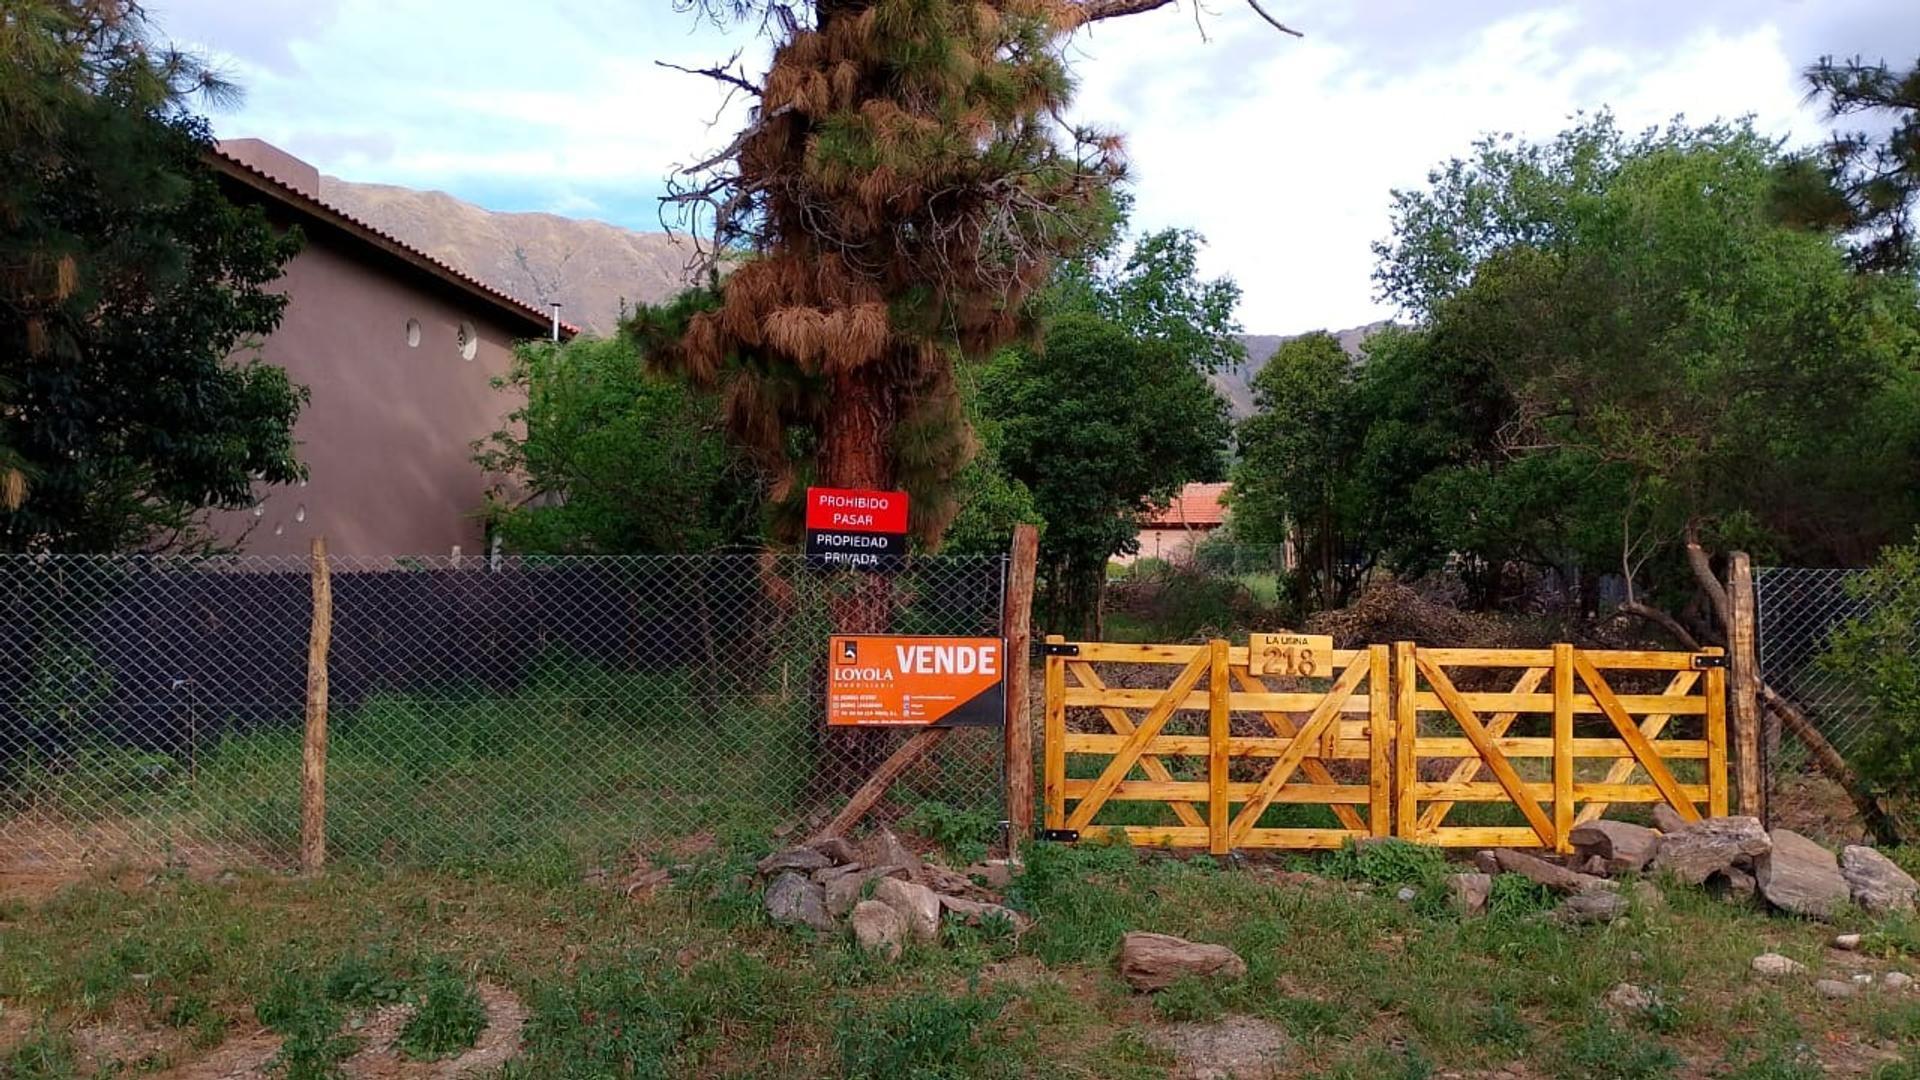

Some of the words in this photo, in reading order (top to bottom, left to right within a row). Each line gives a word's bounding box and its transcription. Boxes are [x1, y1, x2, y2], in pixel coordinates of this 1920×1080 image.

[820, 495, 889, 510] PROHIBIDO
[833, 513, 873, 526] PASAR
[816, 534, 888, 548] PROPIEDAD
[825, 552, 878, 566] PRIVADA
[1266, 636, 1279, 645] LA
[896, 645, 996, 675] VENDE
[1263, 646, 1316, 676] 218
[834, 668, 894, 681] LOYOLA
